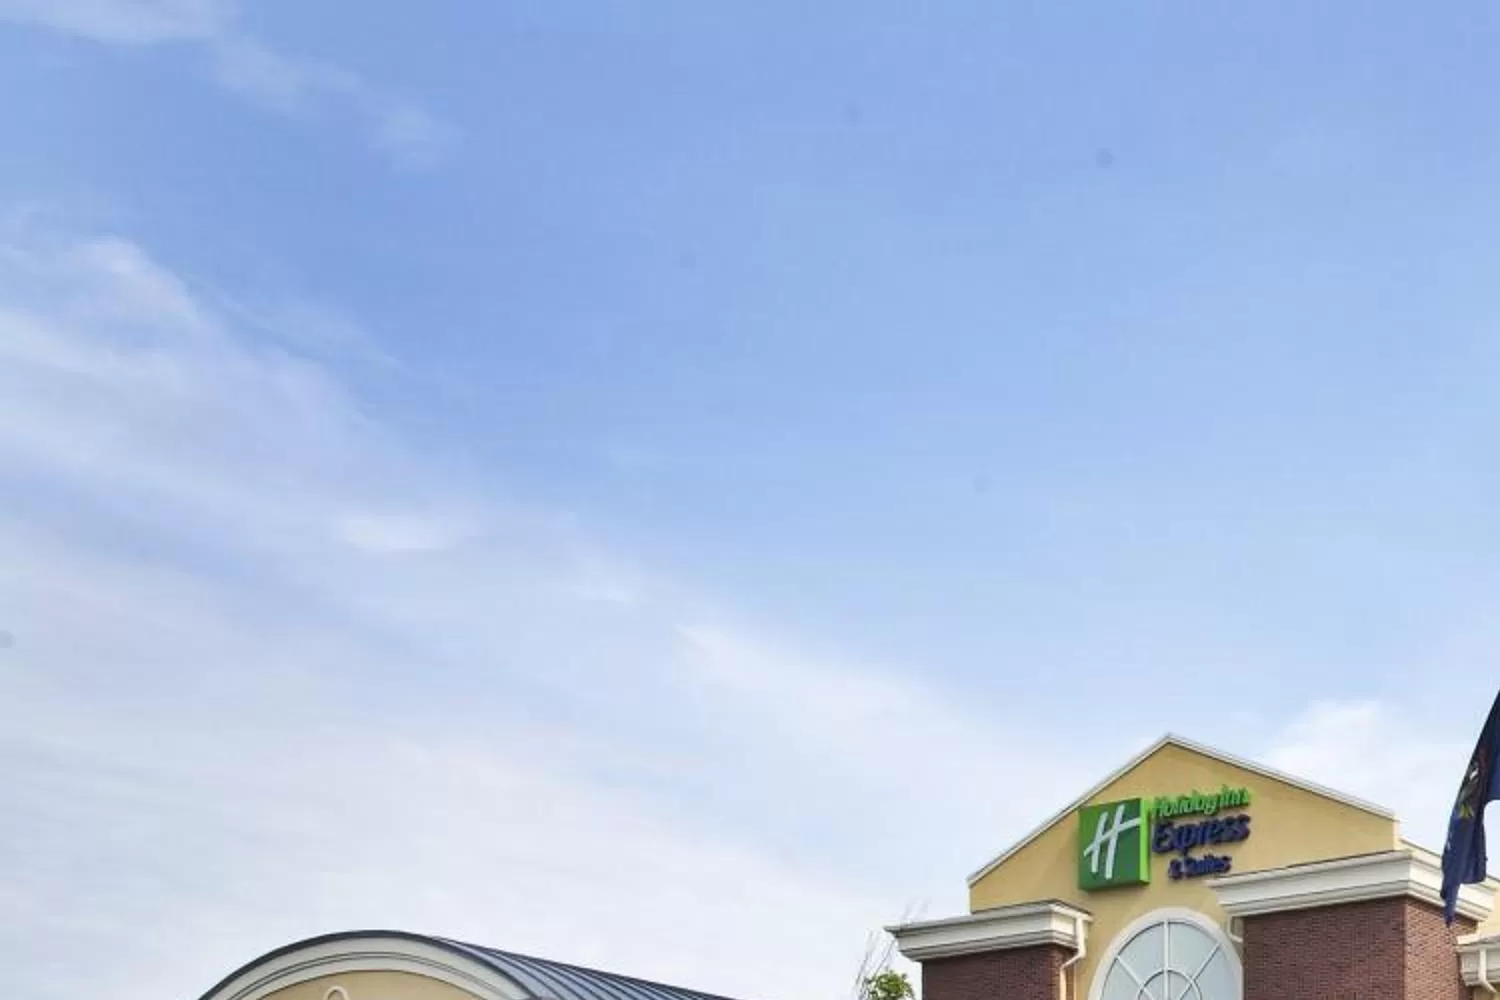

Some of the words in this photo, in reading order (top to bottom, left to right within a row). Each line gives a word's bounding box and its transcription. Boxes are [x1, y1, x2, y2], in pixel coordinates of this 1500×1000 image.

[1152, 789, 1218, 817] Holiday
[1219, 784, 1250, 807] Inn
[1152, 814, 1251, 855] Express
[1184, 854, 1232, 878] Suites
